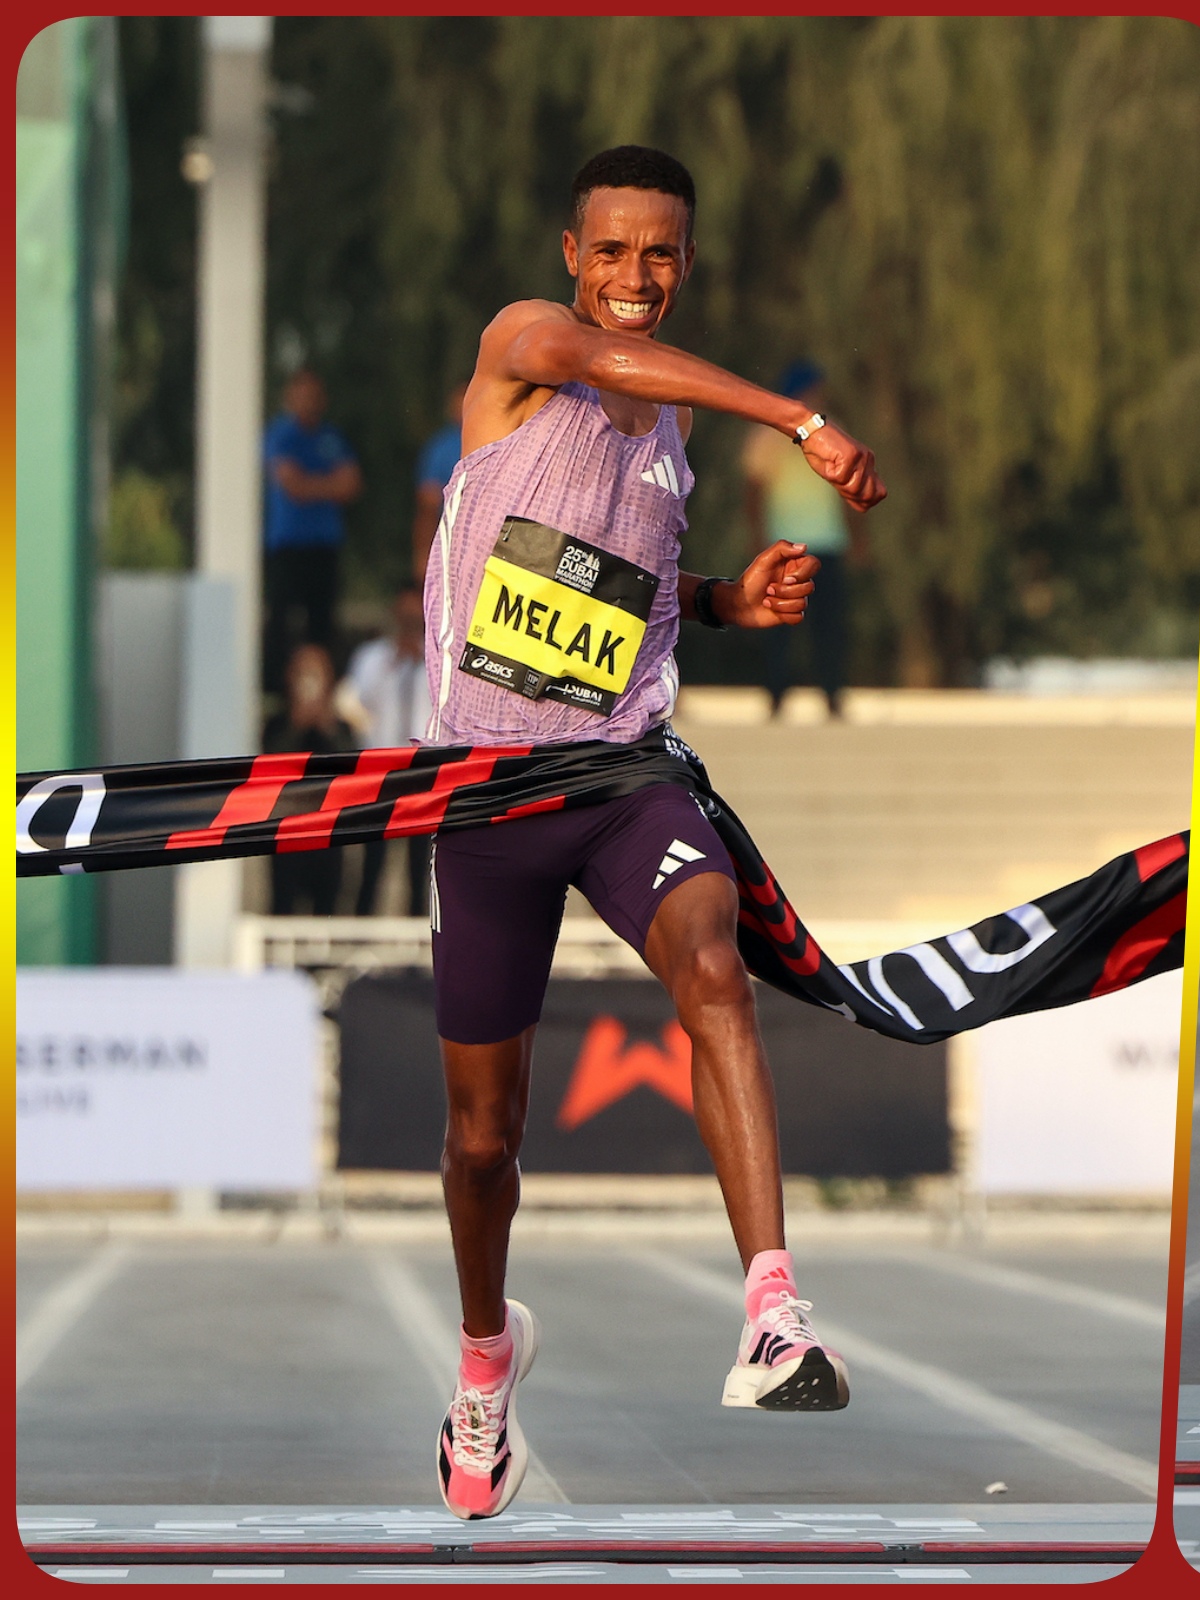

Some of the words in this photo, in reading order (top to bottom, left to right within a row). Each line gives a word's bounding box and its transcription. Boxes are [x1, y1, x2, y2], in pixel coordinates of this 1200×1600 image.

[556, 568, 595, 589] MARATHON
[559, 557, 599, 582] DUBAI
[492, 584, 625, 676] MELAK
